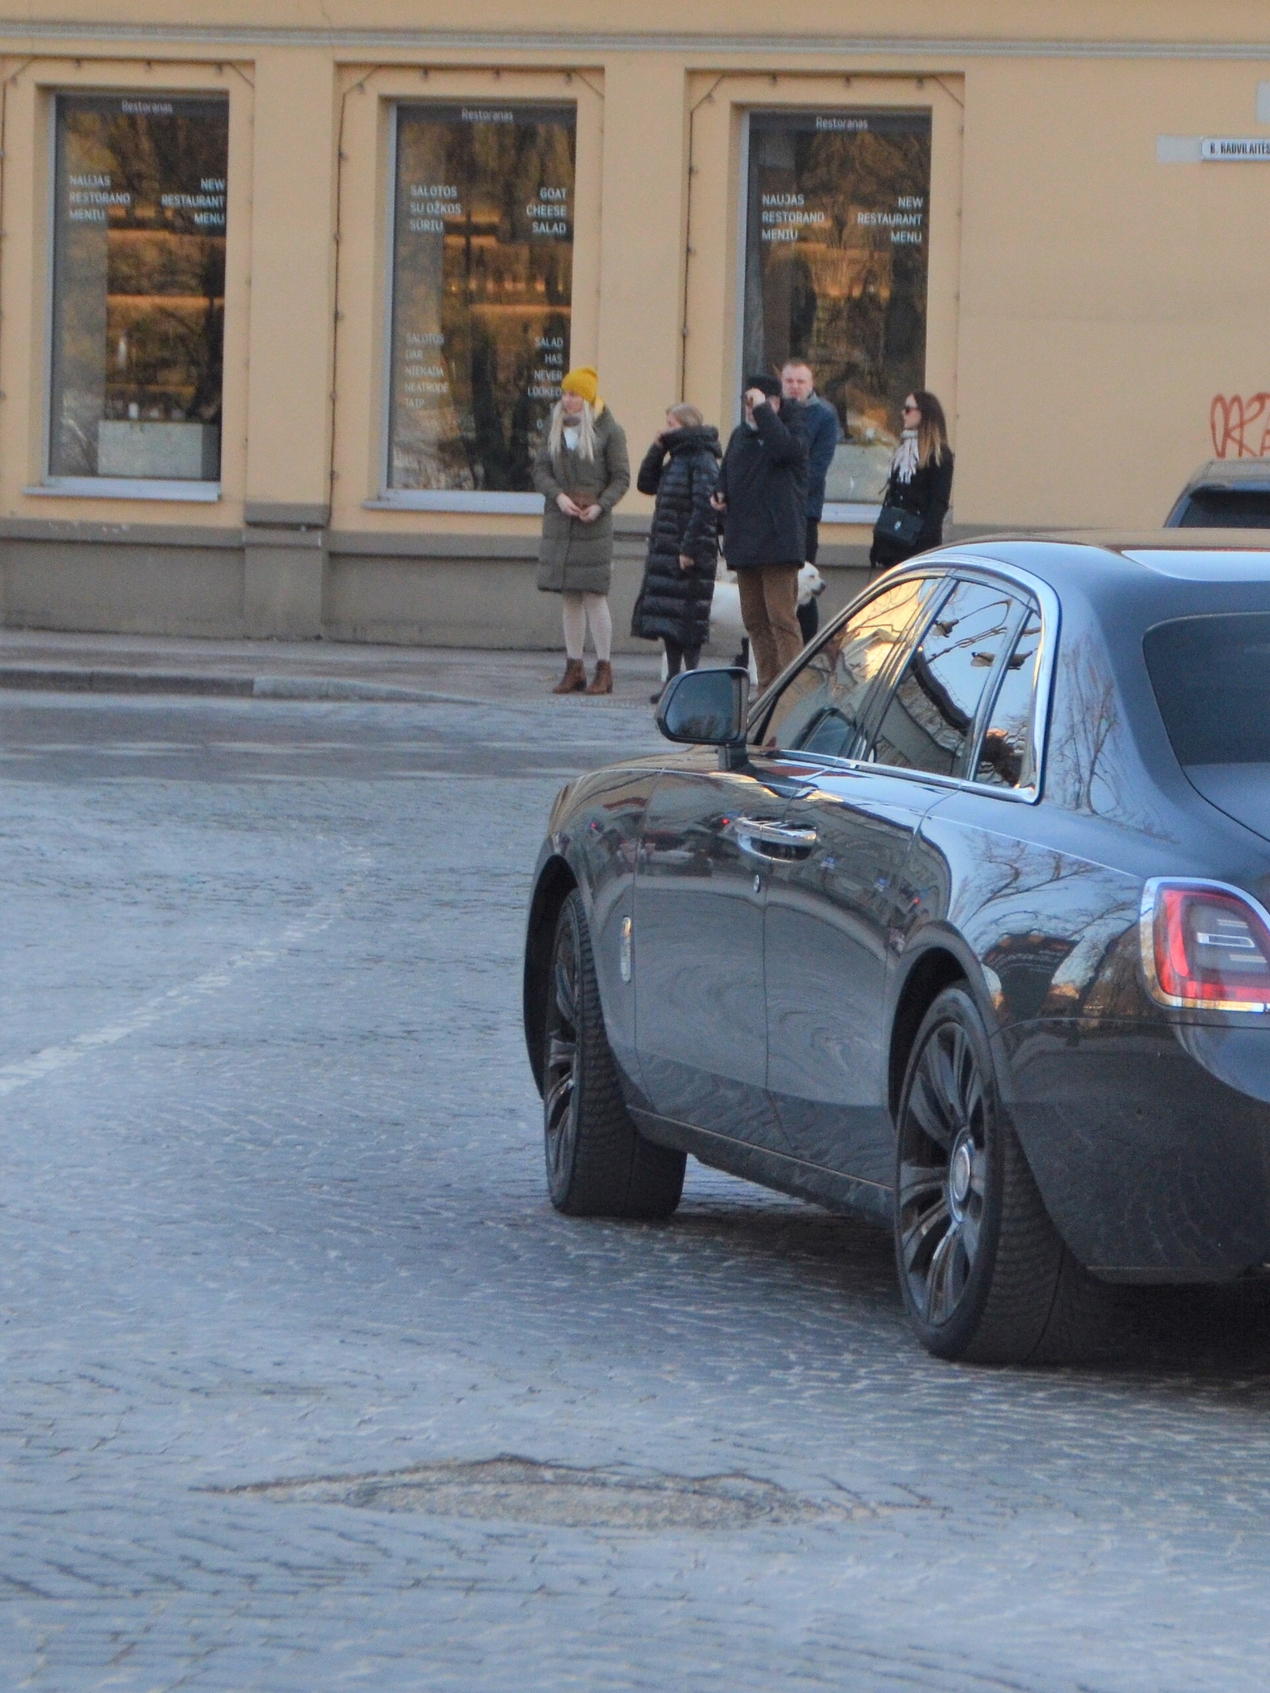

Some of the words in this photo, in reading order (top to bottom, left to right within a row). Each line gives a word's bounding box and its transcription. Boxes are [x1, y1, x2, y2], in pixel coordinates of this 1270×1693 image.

[462, 108, 513, 122] Restoranas
[816, 117, 868, 130] Restoranas
[69, 175, 111, 188] NAUJAS
[201, 178, 226, 190] NEW
[410, 185, 458, 198] SALOTOS
[540, 187, 568, 200] GOAT
[69, 192, 131, 204] RESTORANO
[161, 194, 225, 207] RESTAURANT
[762, 194, 805, 206] NAUJAS
[898, 197, 924, 208] NEW
[410, 202, 424, 214] SU
[526, 205, 567, 217] CHEESE
[194, 213, 225, 225] MENU
[762, 211, 825, 224] RESTORANO
[857, 213, 923, 226] RESTAURANT
[532, 221, 567, 234] SALAD
[762, 229, 799, 241] MENIU
[891, 232, 922, 243] MENU
[535, 337, 564, 349] SALAD
[544, 353, 564, 365] HAS
[534, 370, 563, 381] NEVER
[527, 386, 562, 398] LOOKED
